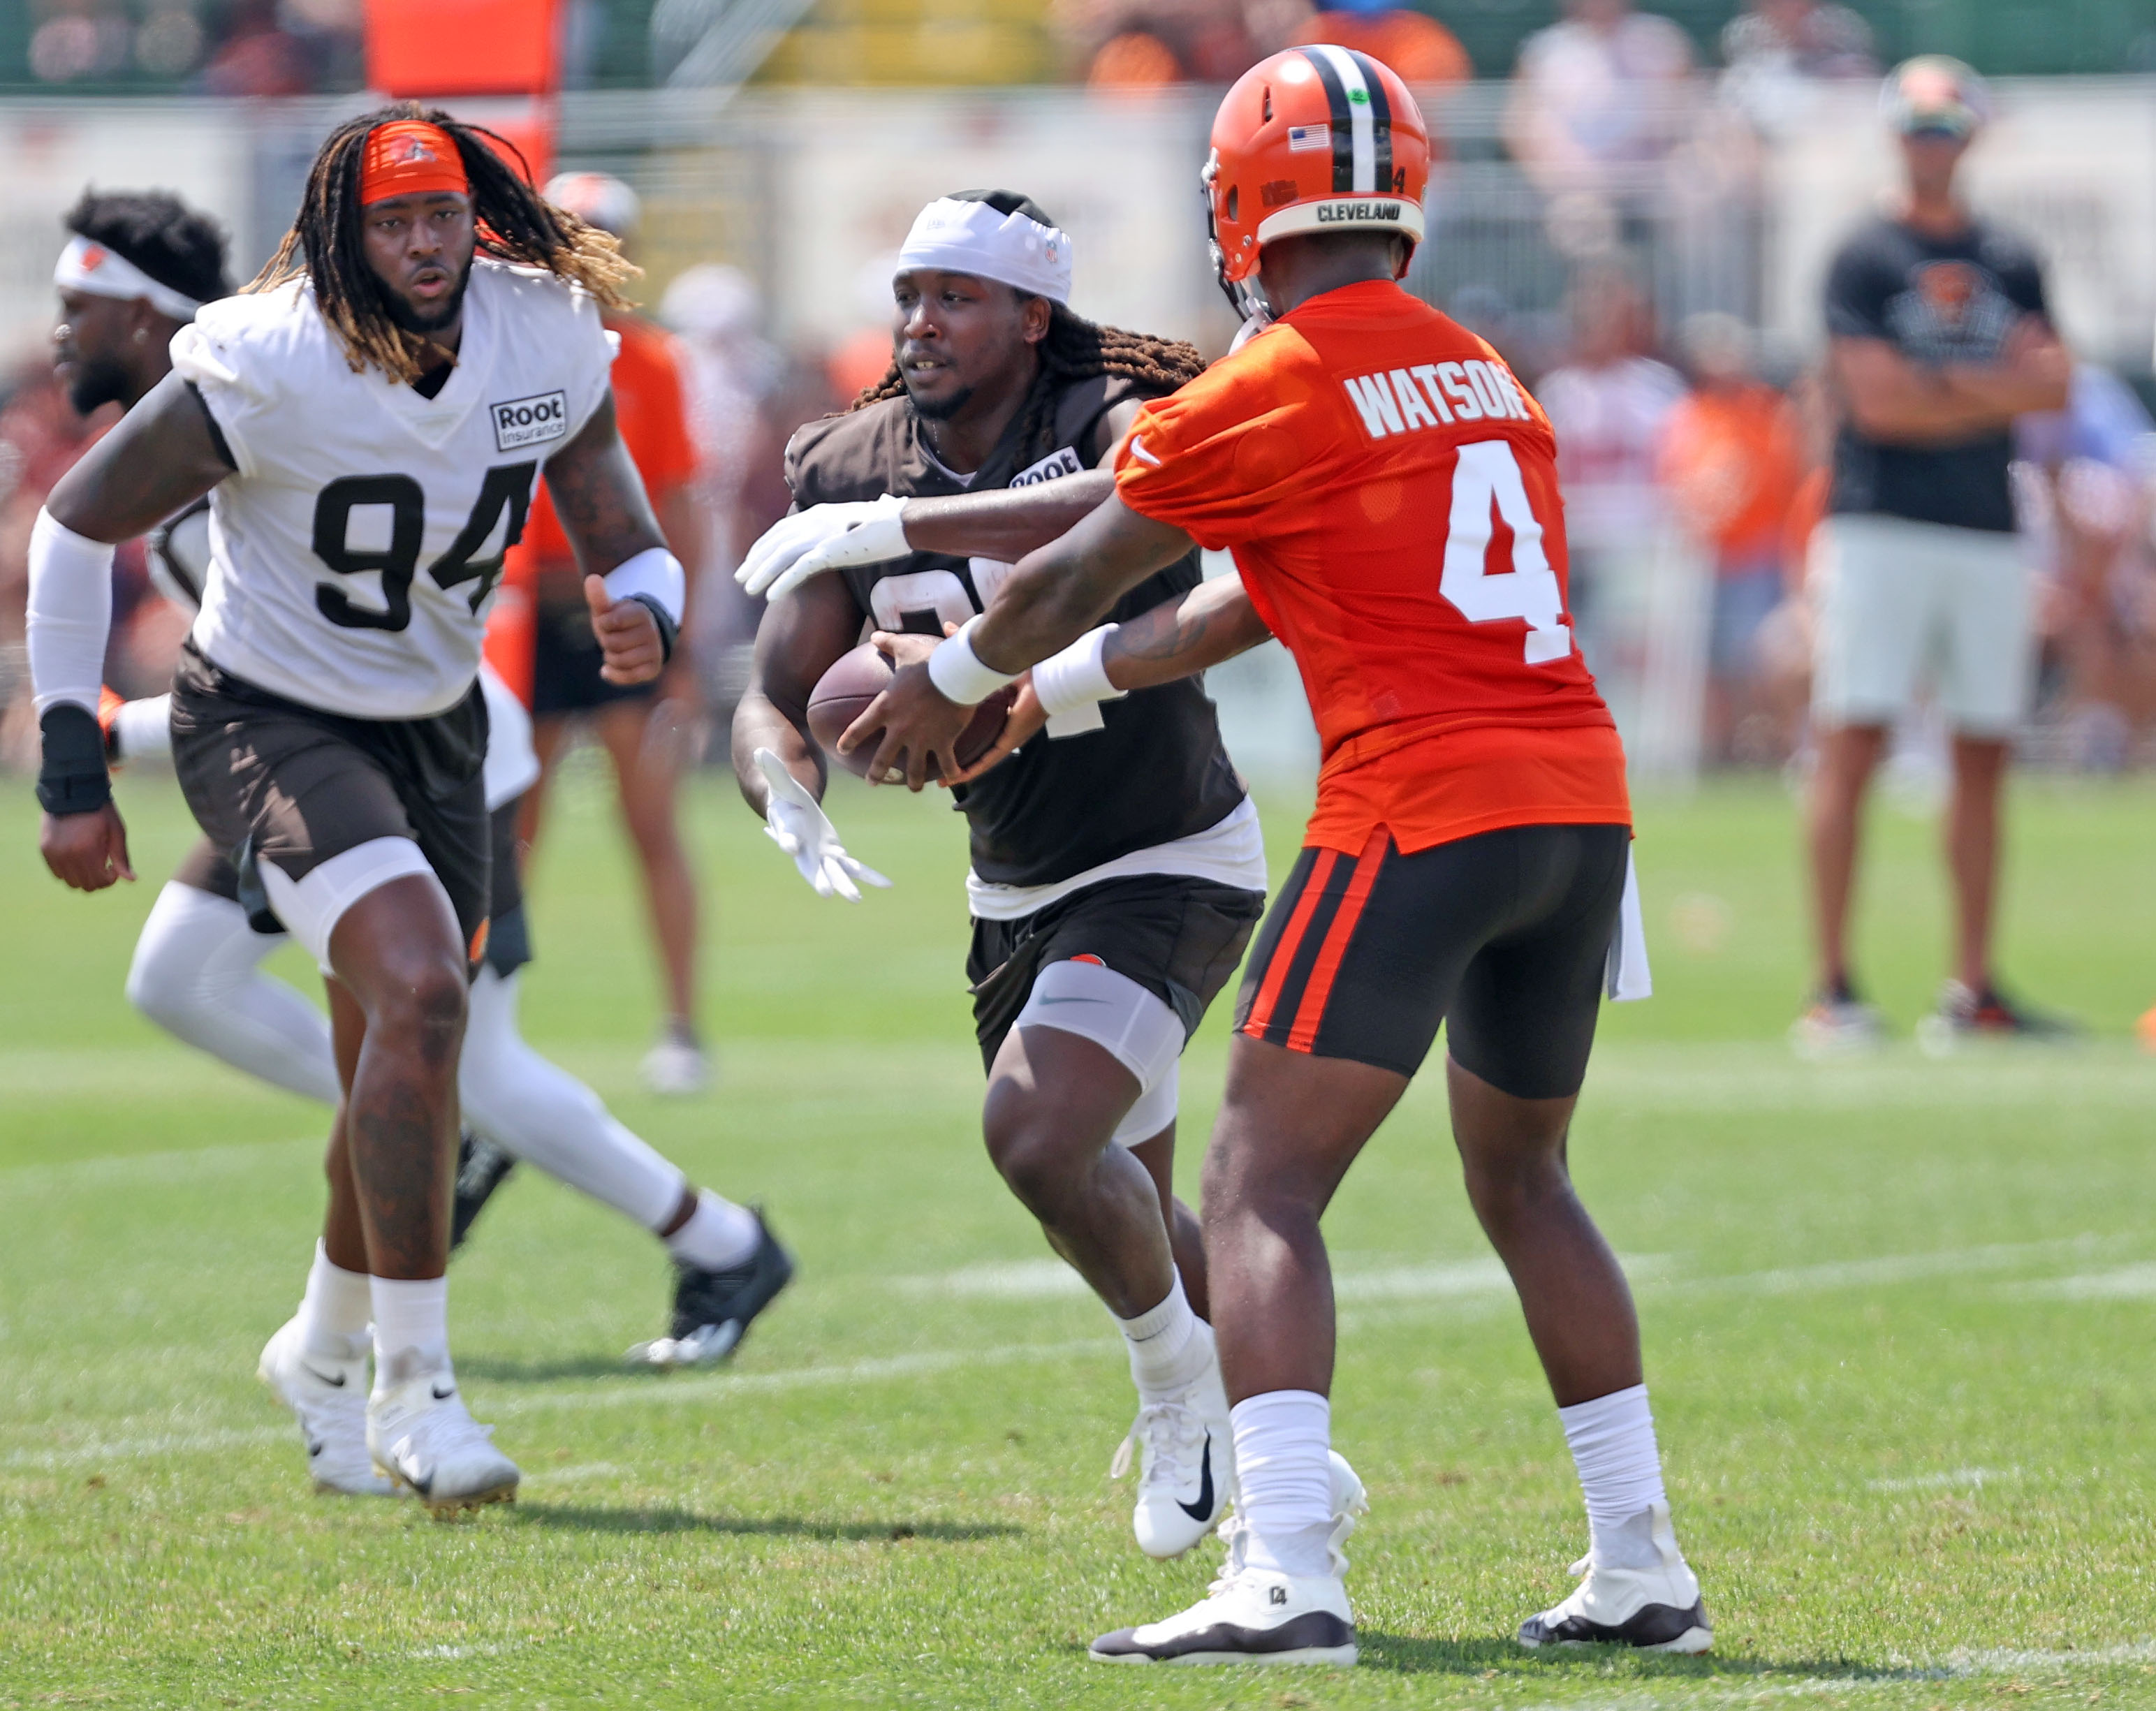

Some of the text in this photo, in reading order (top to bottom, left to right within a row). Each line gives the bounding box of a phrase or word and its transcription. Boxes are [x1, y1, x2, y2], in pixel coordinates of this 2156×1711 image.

[1392, 166, 1405, 193] 4
[1317, 203, 1401, 222] CLEVELAND
[499, 398, 562, 429] Root
[1344, 360, 1531, 439] WATSON
[313, 460, 538, 631] 94
[1439, 440, 1571, 664] 4
